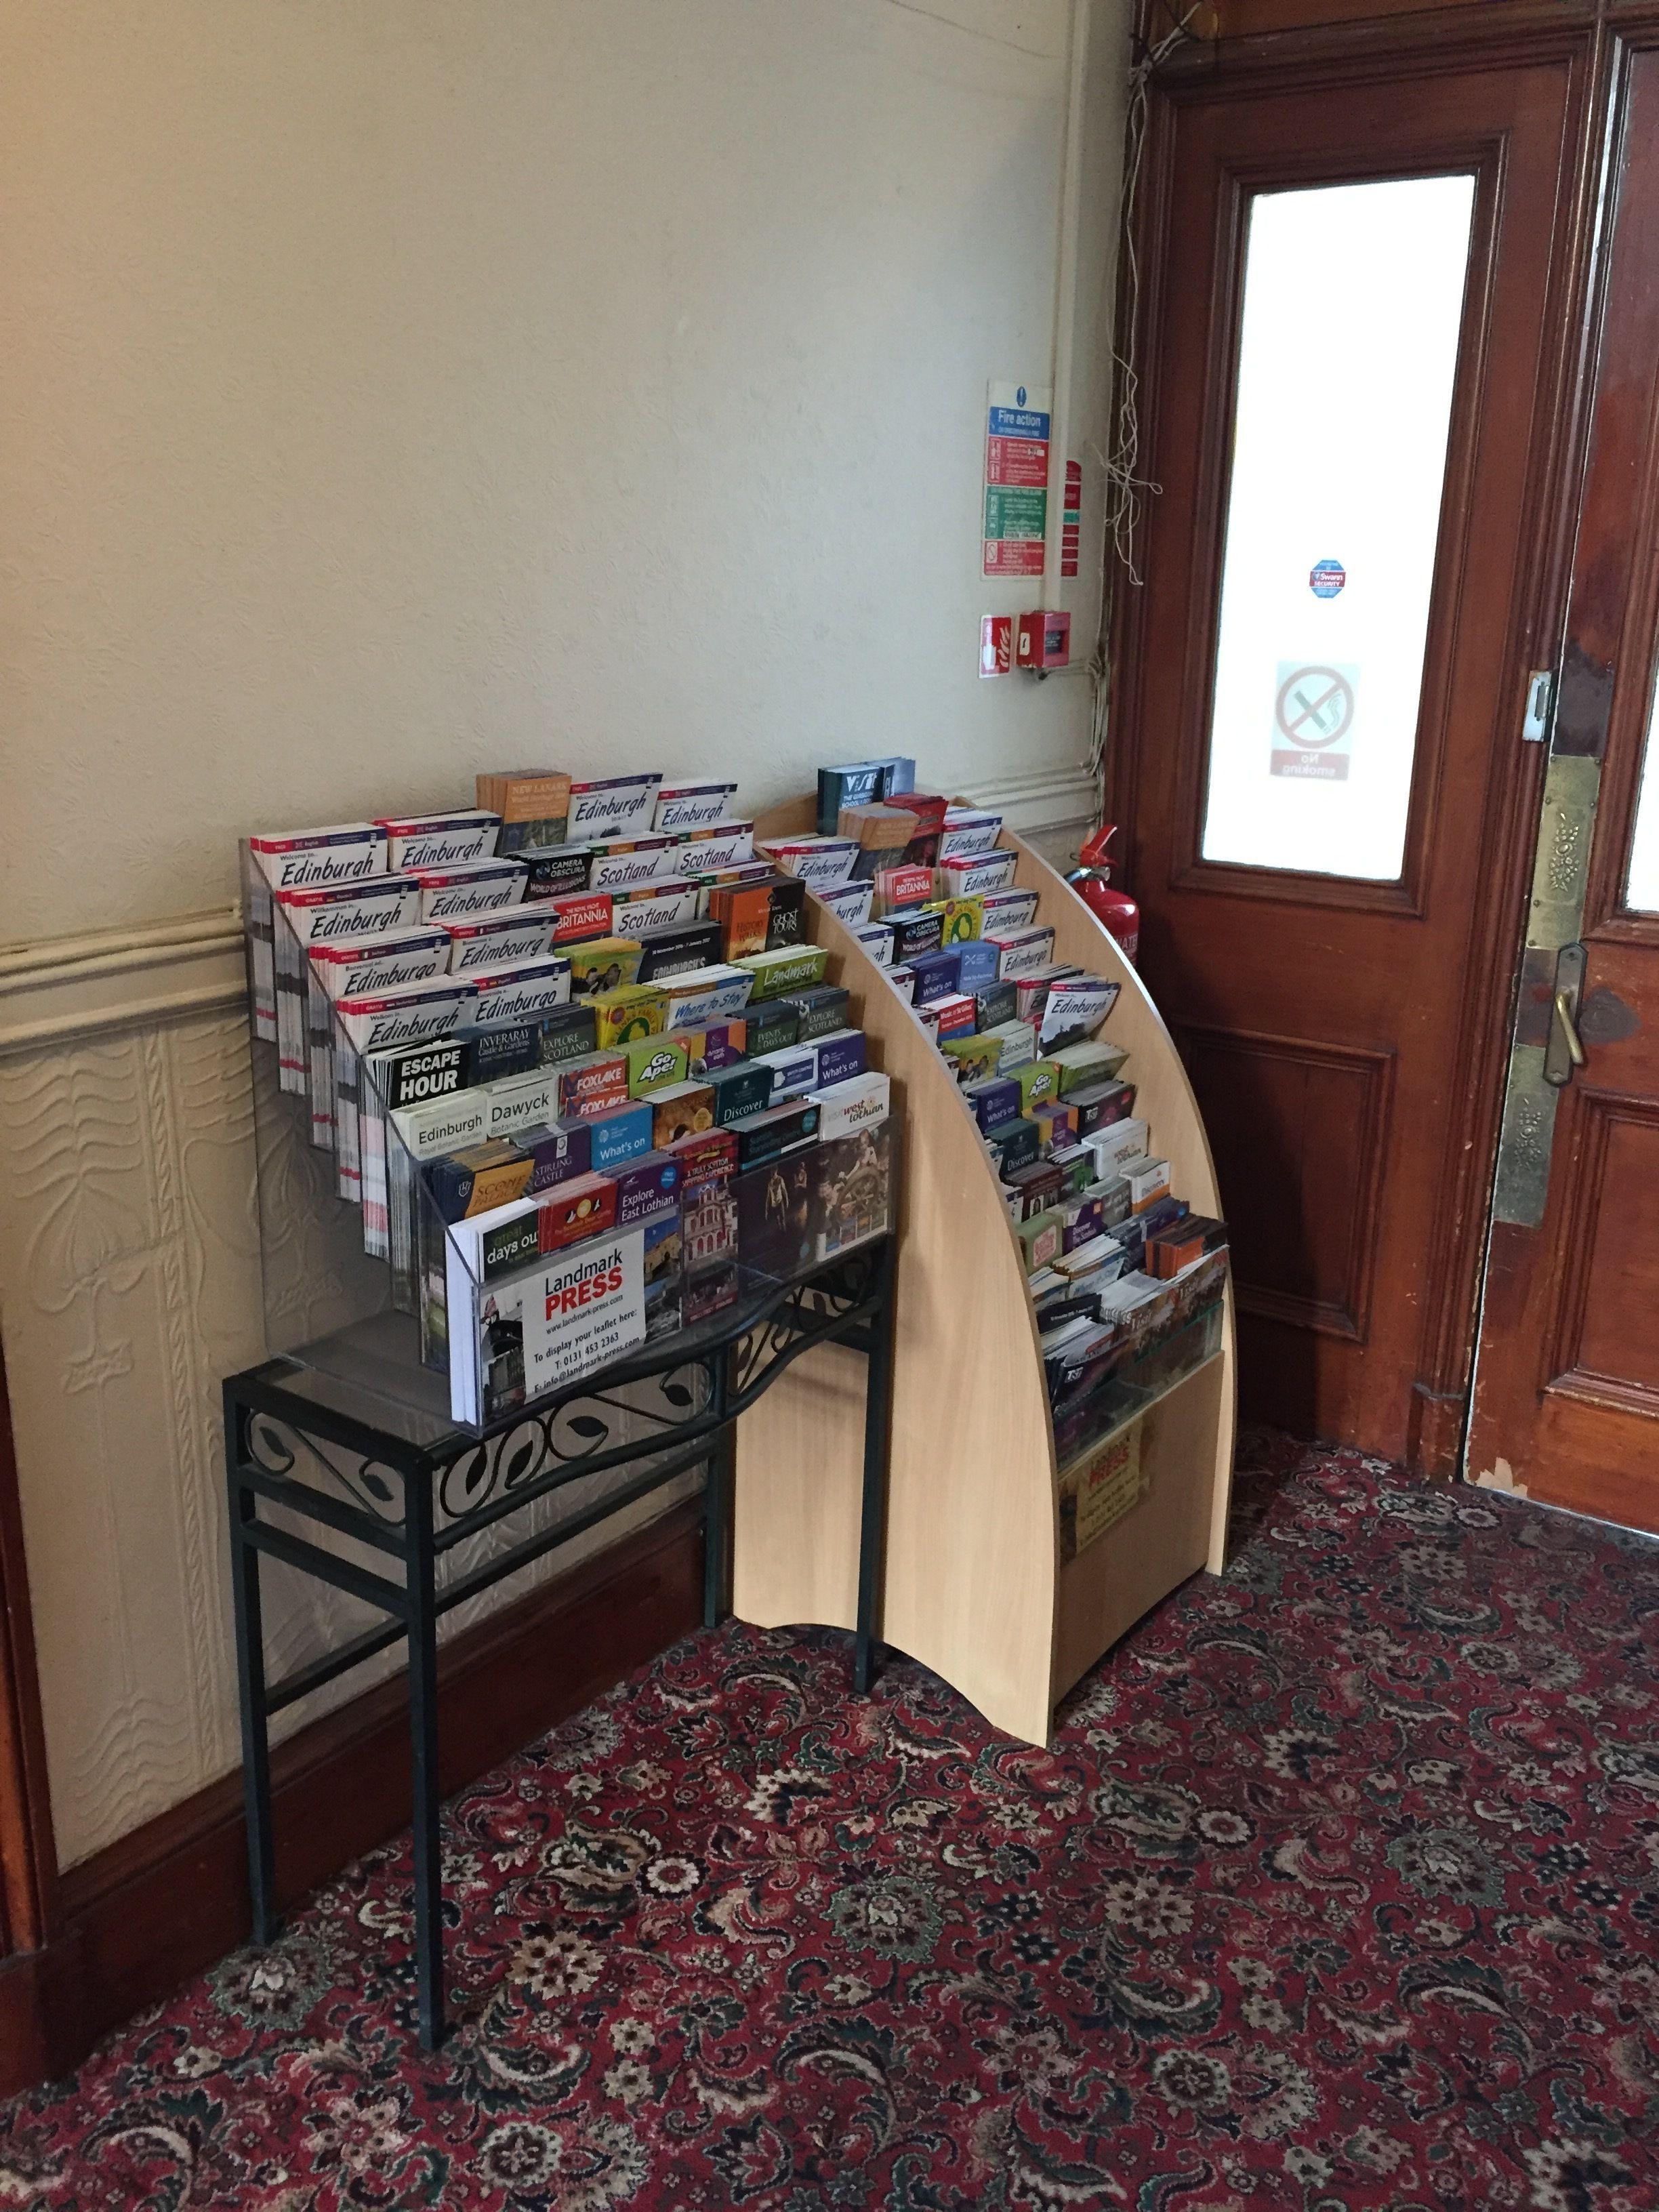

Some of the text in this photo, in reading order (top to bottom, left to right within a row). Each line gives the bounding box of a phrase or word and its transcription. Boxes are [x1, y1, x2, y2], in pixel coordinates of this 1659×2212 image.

[998, 409, 1042, 430] Fire action
[1319, 573, 1343, 582] Swann
[512, 785, 533, 795] NEW
[575, 792, 647, 821] Edinburgh
[661, 800, 724, 826] Edinburgh
[401, 836, 484, 868] Edinburgh
[944, 832, 991, 854] Edinburgh
[552, 859, 583, 871] CAMERA
[680, 843, 737, 871] Scotland
[281, 851, 374, 887] Edinburgh
[550, 866, 586, 879] OBSCURA
[597, 857, 661, 886] Scotland
[796, 857, 848, 880] Edinburgh
[531, 882, 552, 893] WORLD
[897, 881, 930, 896] BRITANNIA
[964, 869, 1008, 893] Edinburgh
[430, 886, 513, 918] Edinburgh
[836, 899, 864, 922] burgh
[310, 903, 402, 939] Edinburgh
[557, 908, 609, 930] BRITANNIA
[618, 902, 680, 933] Scotland
[737, 919, 764, 933] HISTORY
[773, 908, 799, 924] GHOST
[916, 920, 939, 933] CAMERA
[984, 911, 1029, 930] Edimbourg
[773, 920, 798, 936] TOURS
[916, 926, 941, 939] OBSCURA
[460, 938, 546, 968] Edimbourg
[1004, 950, 1048, 972] Edimburgo
[344, 963, 437, 996] Edimburgo
[764, 957, 818, 987] Landmark
[923, 981, 953, 997] What's on
[474, 989, 557, 1023] Edimburgo
[674, 1003, 705, 1021] Where
[709, 998, 720, 1008] to
[720, 993, 746, 1008] Stay
[808, 1008, 836, 1024] EXPLORE
[1051, 998, 1107, 1016] Edinburgh
[368, 1006, 459, 1046] Edinburgh
[758, 1028, 781, 1044] EVENTS
[808, 1018, 842, 1033] SCOTLAND
[478, 1028, 531, 1049] INVERARAY
[478, 1046, 497, 1057] Castle
[504, 1040, 531, 1051] Gardens
[543, 1032, 579, 1050] EXPLORE
[763, 1032, 794, 1048] DAYS OUT
[1000, 1037, 1033, 1057] Edinburgh
[543, 1041, 590, 1061] SCOTLAND
[651, 1052, 672, 1066] Go
[401, 1050, 462, 1077] ESCAPE
[640, 1057, 678, 1082] Ape!
[823, 1063, 848, 1080] What's
[848, 1059, 859, 1069] on
[399, 1069, 458, 1101] HOUR
[577, 1067, 623, 1091] FOXLAKE
[1036, 1074, 1050, 1086] Go
[492, 1092, 550, 1122] Dawyck
[724, 1099, 763, 1122] Discover
[844, 1099, 865, 1115] west
[849, 1102, 884, 1123] lothian
[987, 1109, 1007, 1124] What's
[419, 1115, 483, 1145] Edinburgh
[491, 1111, 550, 1138] Botanic Garden
[600, 1137, 645, 1160] What's on
[535, 1155, 573, 1177] STIRLING
[1007, 1153, 1035, 1171] Discover
[476, 1173, 527, 1196] SCONE
[534, 1171, 565, 1188] CASTLE
[621, 1194, 674, 1222] East Lothian
[622, 1188, 655, 1210] Explore
[487, 1239, 518, 1265] days
[520, 1230, 538, 1248] ou
[493, 1225, 523, 1248] great
[544, 1248, 623, 1296] Landmark
[545, 1266, 623, 1322] PRESS
[534, 1307, 638, 1364] To display your leaflet here:
[554, 1332, 619, 1371] T: 0131 453 2363
[534, 1336, 640, 1395] E: info@landmark-press.com
